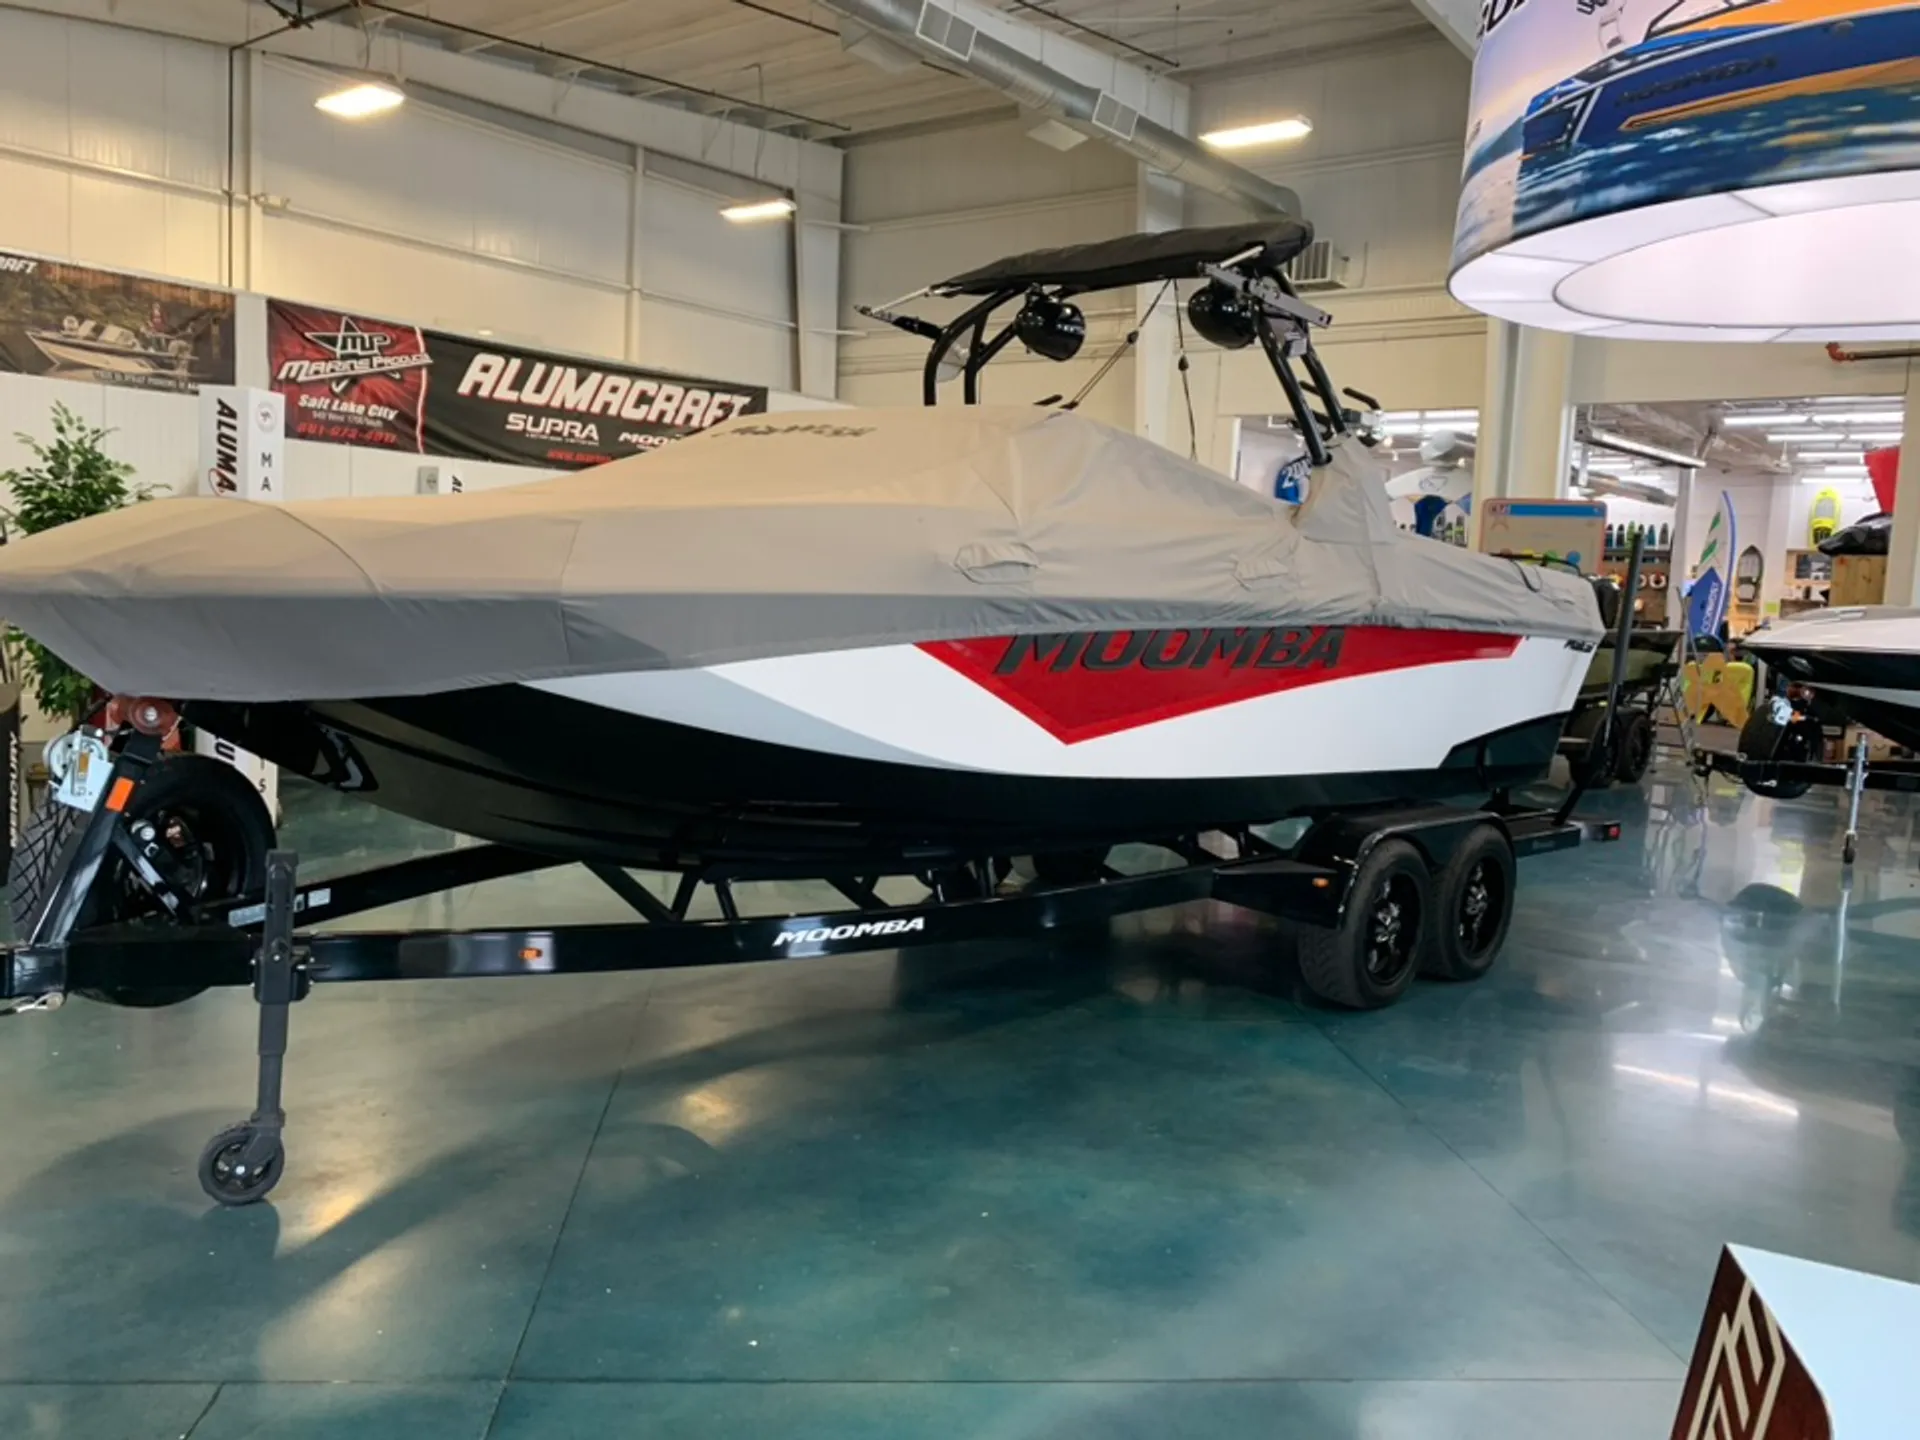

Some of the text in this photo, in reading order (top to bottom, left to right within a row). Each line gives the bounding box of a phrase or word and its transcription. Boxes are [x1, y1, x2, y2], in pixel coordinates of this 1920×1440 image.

[277, 358, 370, 382] MARINE
[457, 353, 751, 428] ALUMACRAFT
[298, 394, 330, 410] Salt
[331, 398, 366, 415] Lake
[367, 404, 399, 422] City
[505, 412, 600, 441] SUPRA
[618, 431, 682, 447] MOO
[993, 625, 1347, 674] MOOMBA
[9, 731, 18, 848] MERCURY
[772, 917, 925, 946] MOOMBA
